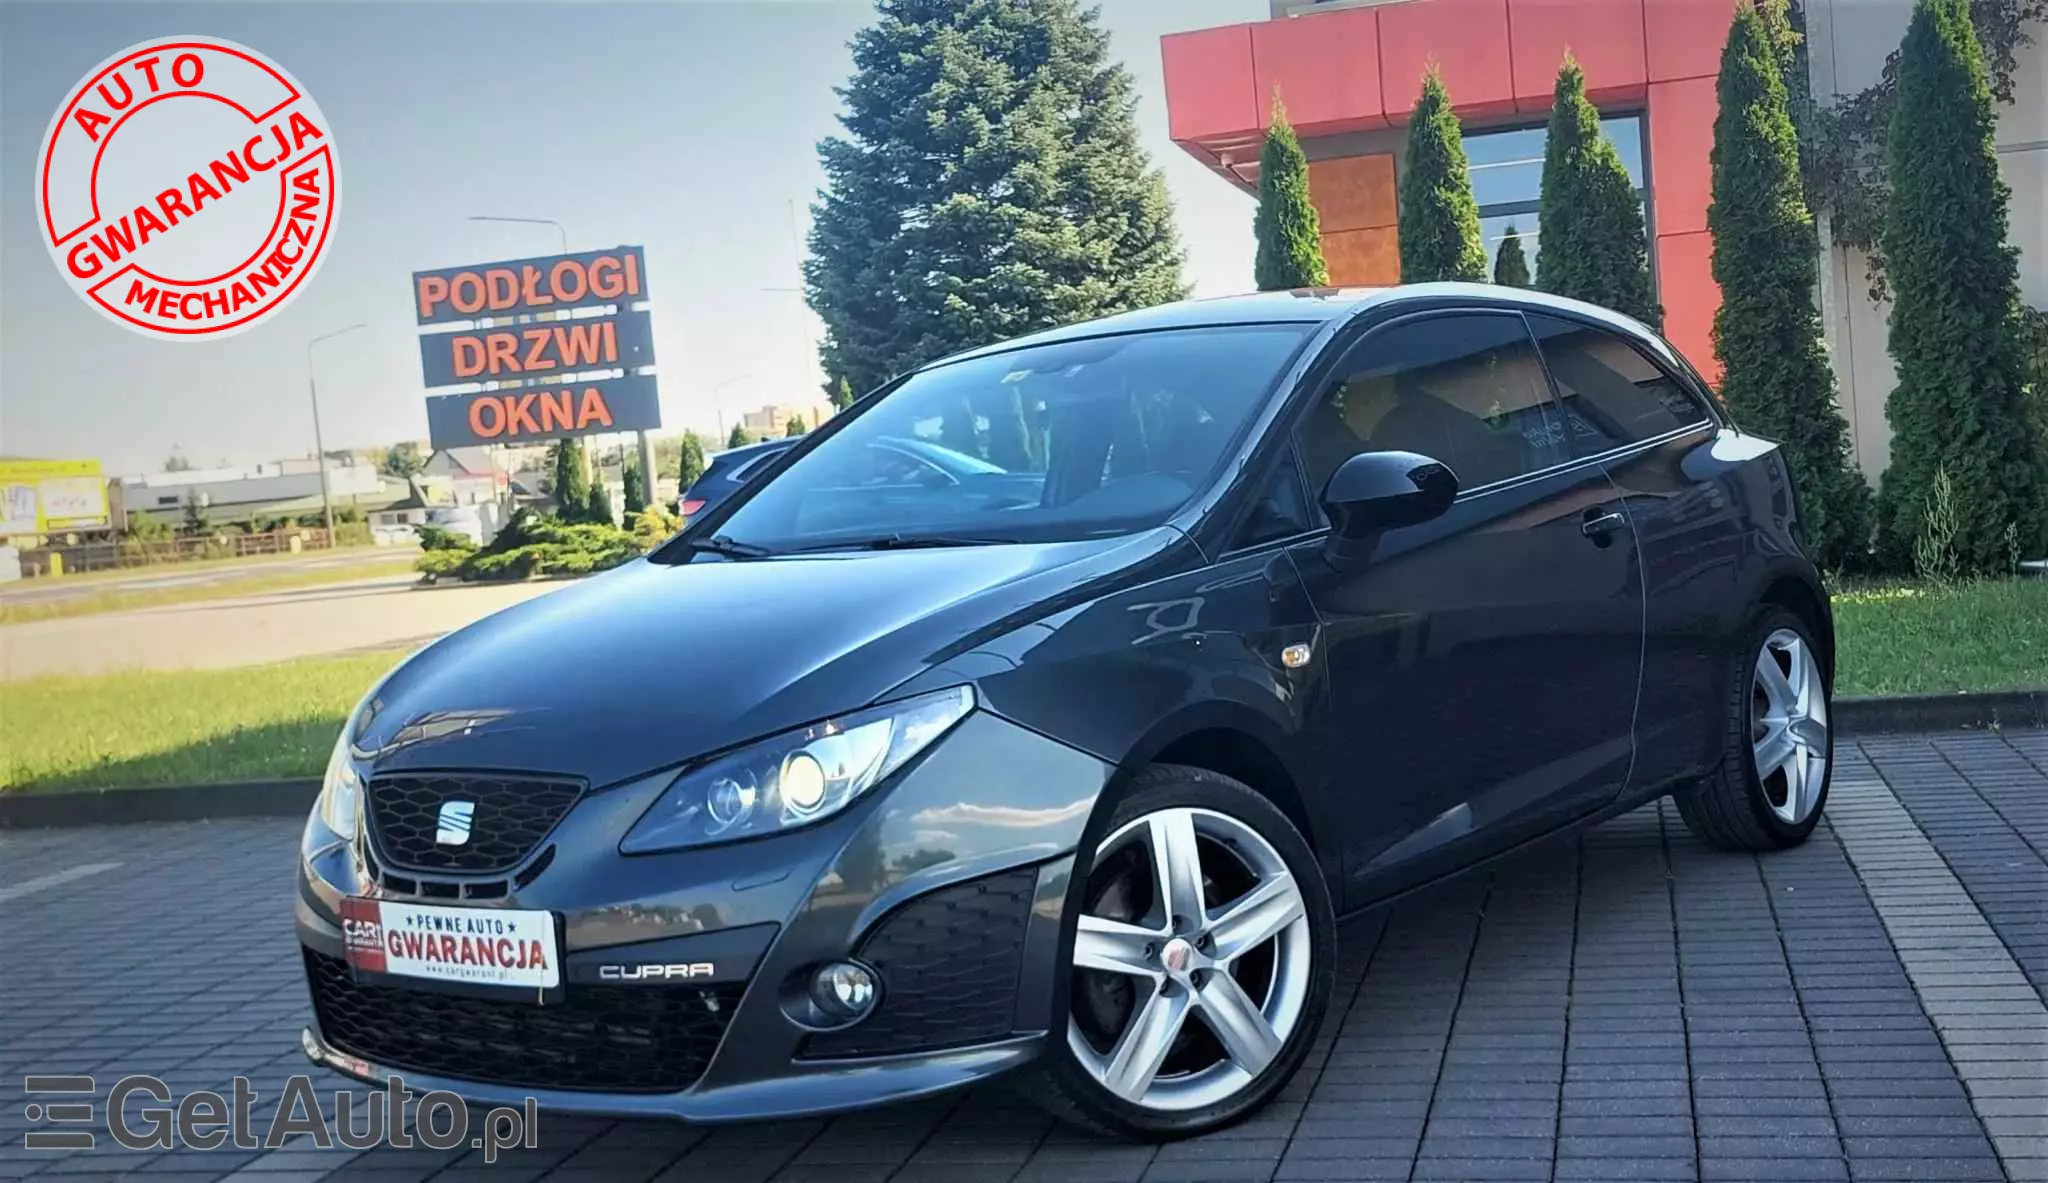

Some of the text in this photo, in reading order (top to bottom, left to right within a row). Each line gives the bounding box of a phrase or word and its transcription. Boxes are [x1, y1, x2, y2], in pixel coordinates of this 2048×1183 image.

[417, 254, 639, 318] PODŁOGI
[452, 321, 618, 378] DRZWI
[468, 387, 613, 438] OKNA
[416, 913, 504, 935] PEWNE AUTO
[387, 928, 549, 970] GWARANCJA
[600, 962, 714, 979] CUPRA
